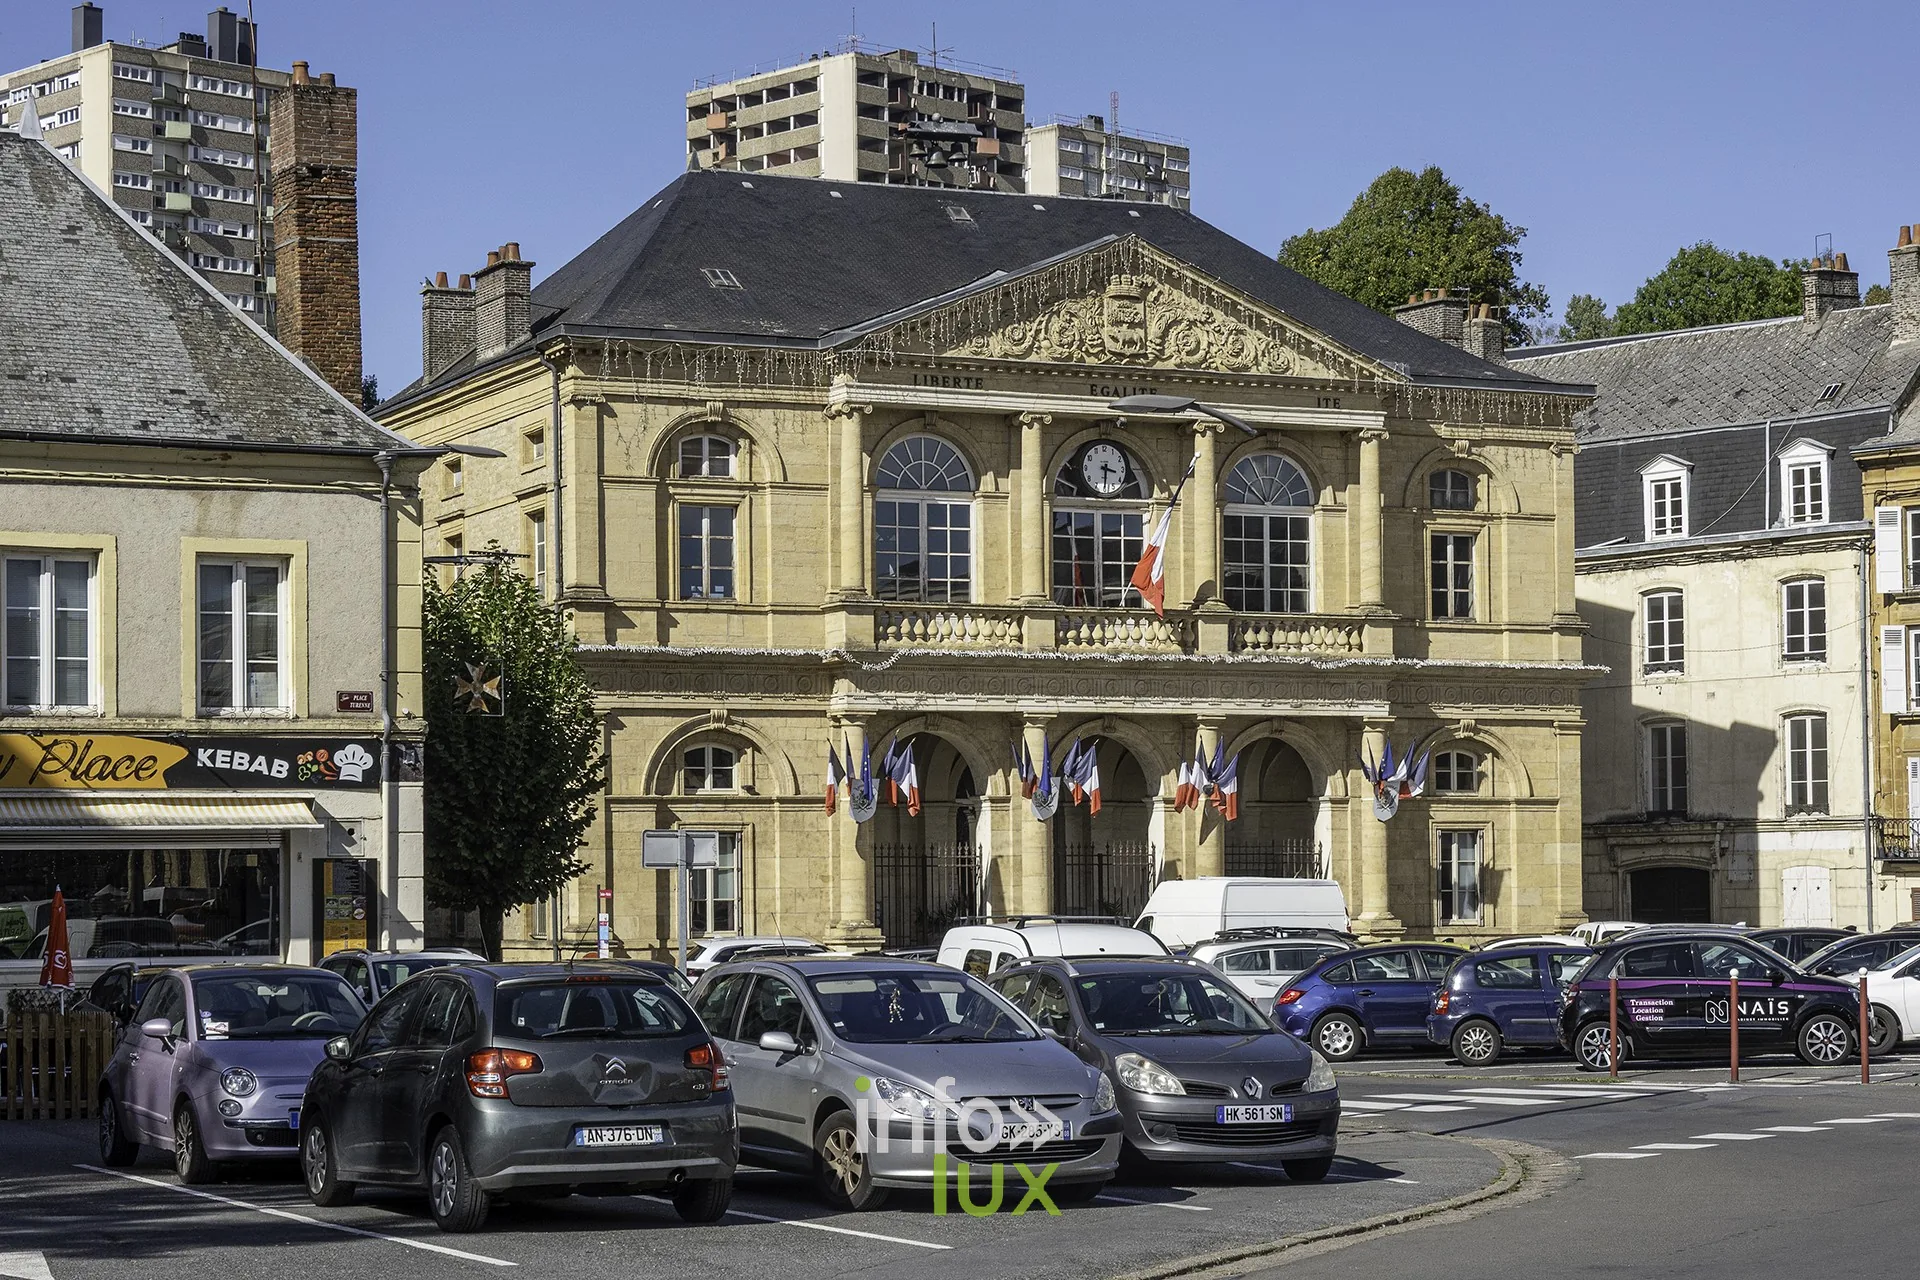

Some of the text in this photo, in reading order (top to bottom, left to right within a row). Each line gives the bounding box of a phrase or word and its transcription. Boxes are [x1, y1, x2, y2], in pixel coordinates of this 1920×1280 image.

[913, 374, 984, 390] LIBERTE
[28, 738, 158, 785] Place
[196, 748, 290, 779] KEBAB
[1736, 997, 1789, 1015] NAÏS
[1226, 1106, 1284, 1121] HK-561-SN
